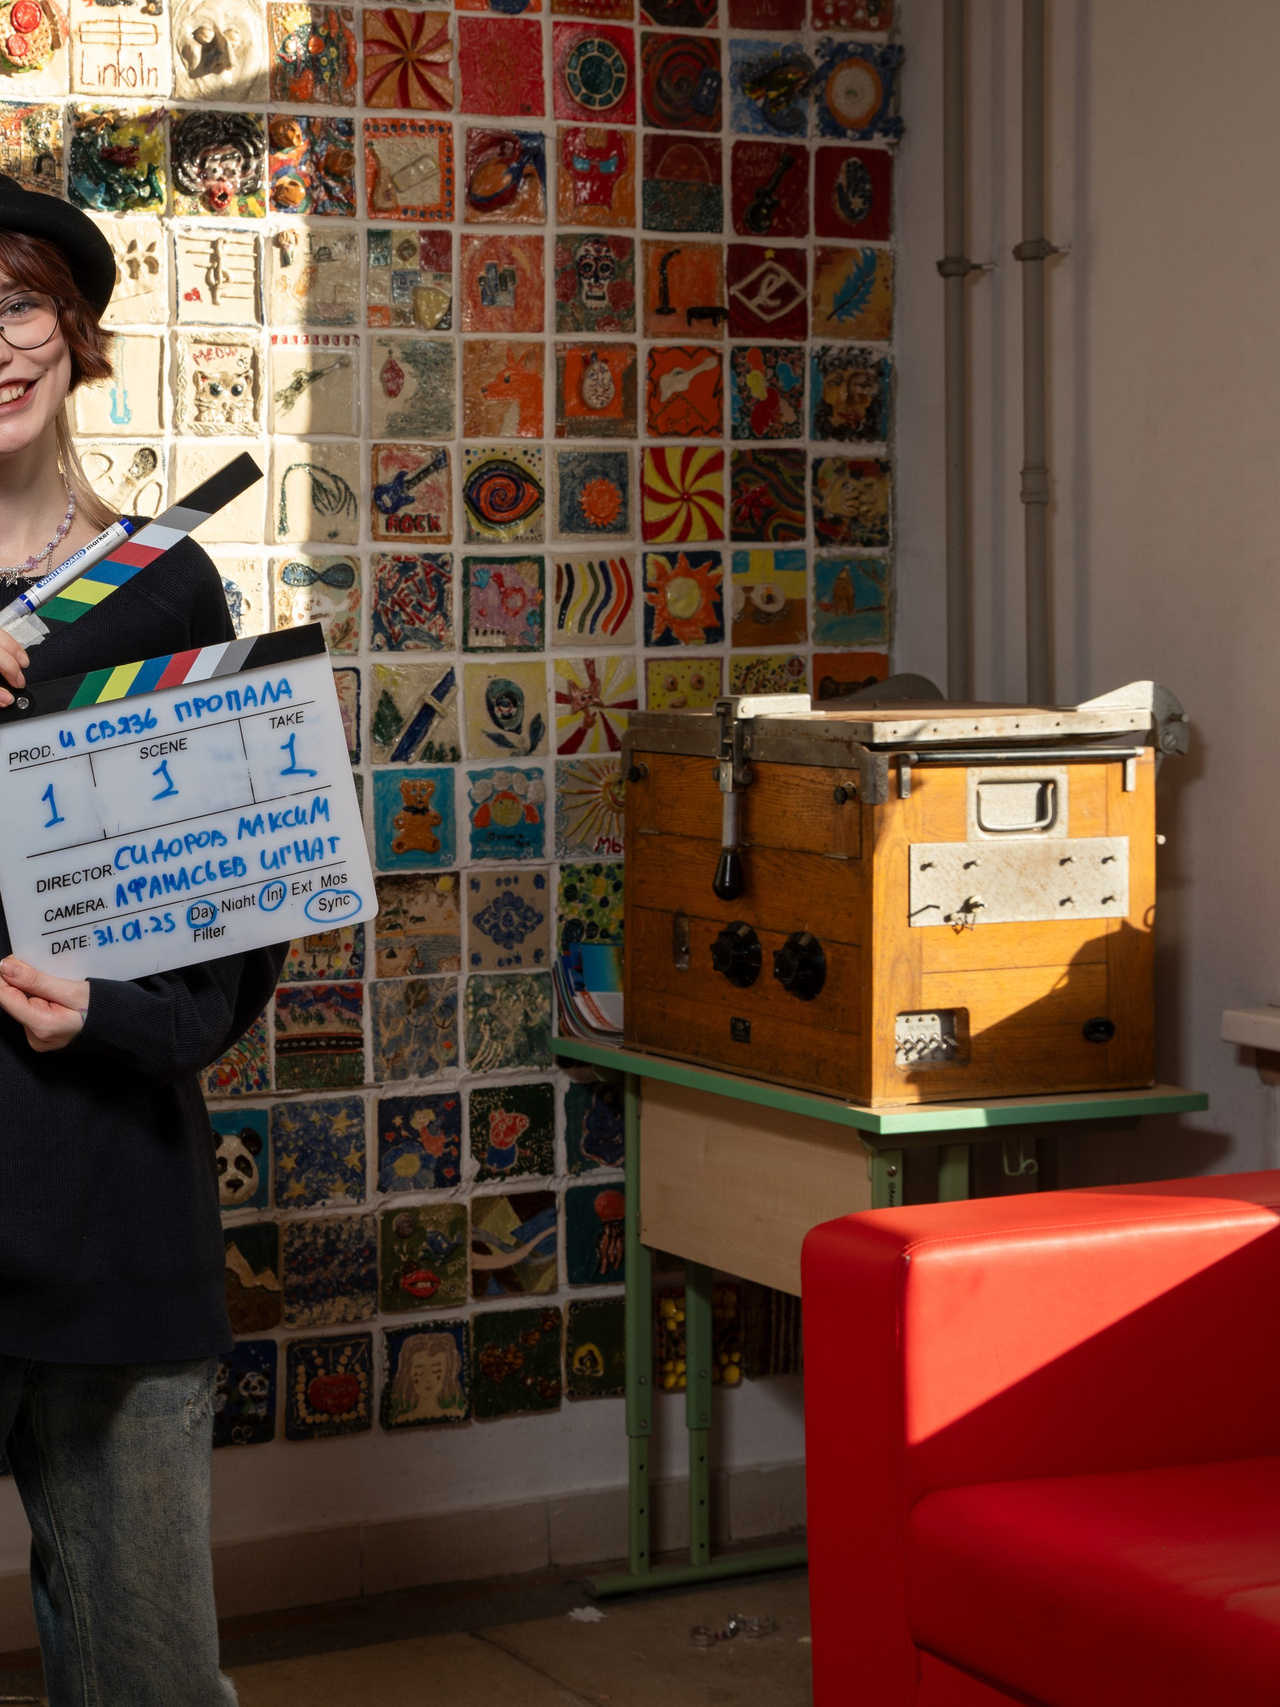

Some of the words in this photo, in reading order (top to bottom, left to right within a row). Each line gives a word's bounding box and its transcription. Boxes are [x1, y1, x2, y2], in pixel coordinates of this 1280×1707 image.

[385, 513, 443, 534] ROCK
[38, 550, 86, 588] WHITEBOARD
[86, 531, 110, 551] marker
[174, 678, 293, 723] ПРОПАЛА
[269, 711, 305, 730] TAKE
[8, 745, 55, 766] PROD.
[139, 737, 188, 760] SCENE
[279, 733, 318, 777] 1
[151, 760, 179, 801] 1
[41, 784, 65, 828] 1
[114, 830, 228, 872] СИДОРОВ
[237, 796, 330, 842] МАКСИМ
[115, 856, 247, 907] АФАНАСЬЕВ
[260, 835, 341, 871] ИГНАТ
[190, 903, 216, 922] Day
[266, 886, 283, 902] Int
[291, 879, 313, 897] Ext
[320, 873, 348, 888] Mos
[318, 894, 351, 913] Sync
[51, 935, 91, 955] DATE:
[193, 924, 226, 943] Filter
